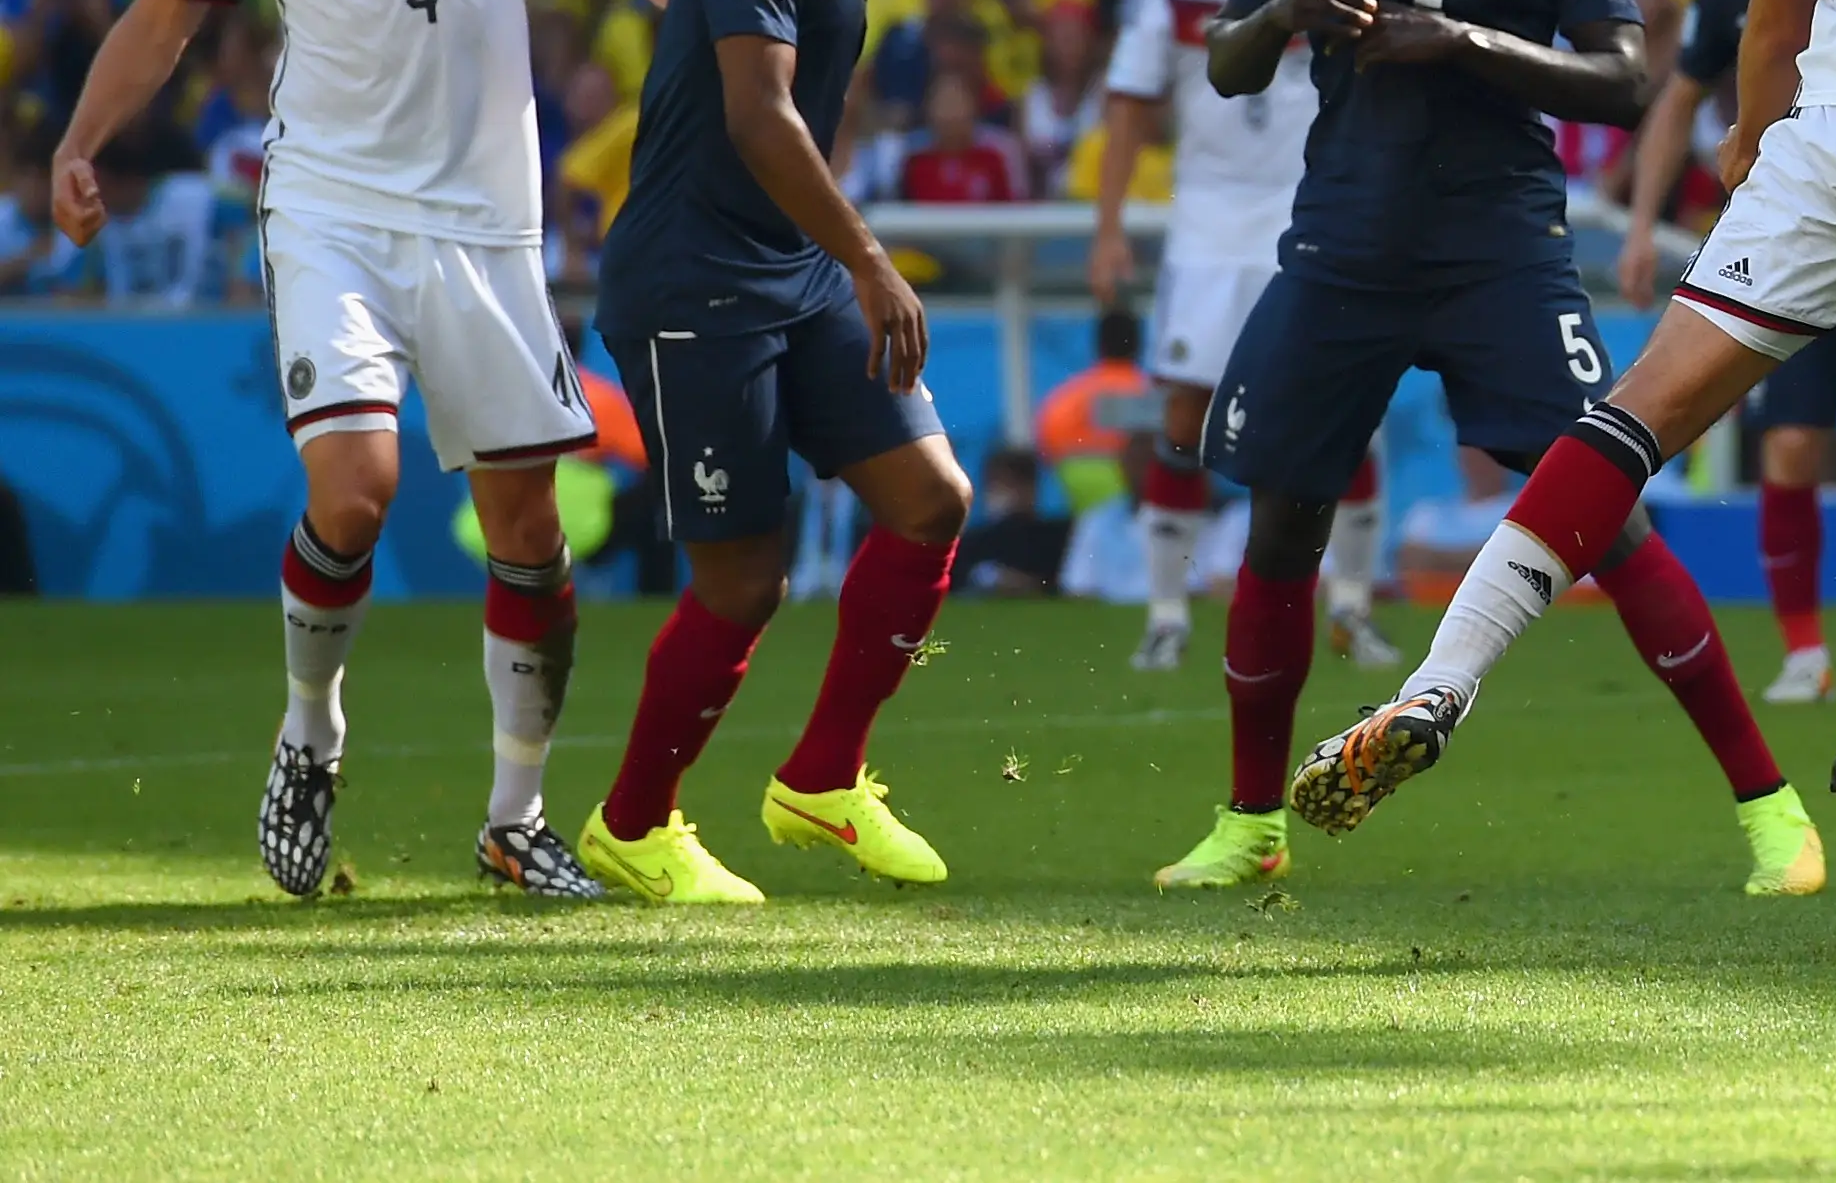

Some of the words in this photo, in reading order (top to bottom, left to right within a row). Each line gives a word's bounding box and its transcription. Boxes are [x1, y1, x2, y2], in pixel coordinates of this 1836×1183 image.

[1718, 268, 1753, 287] adidas
[1558, 313, 1602, 384] 5
[1507, 561, 1551, 605] adidas
